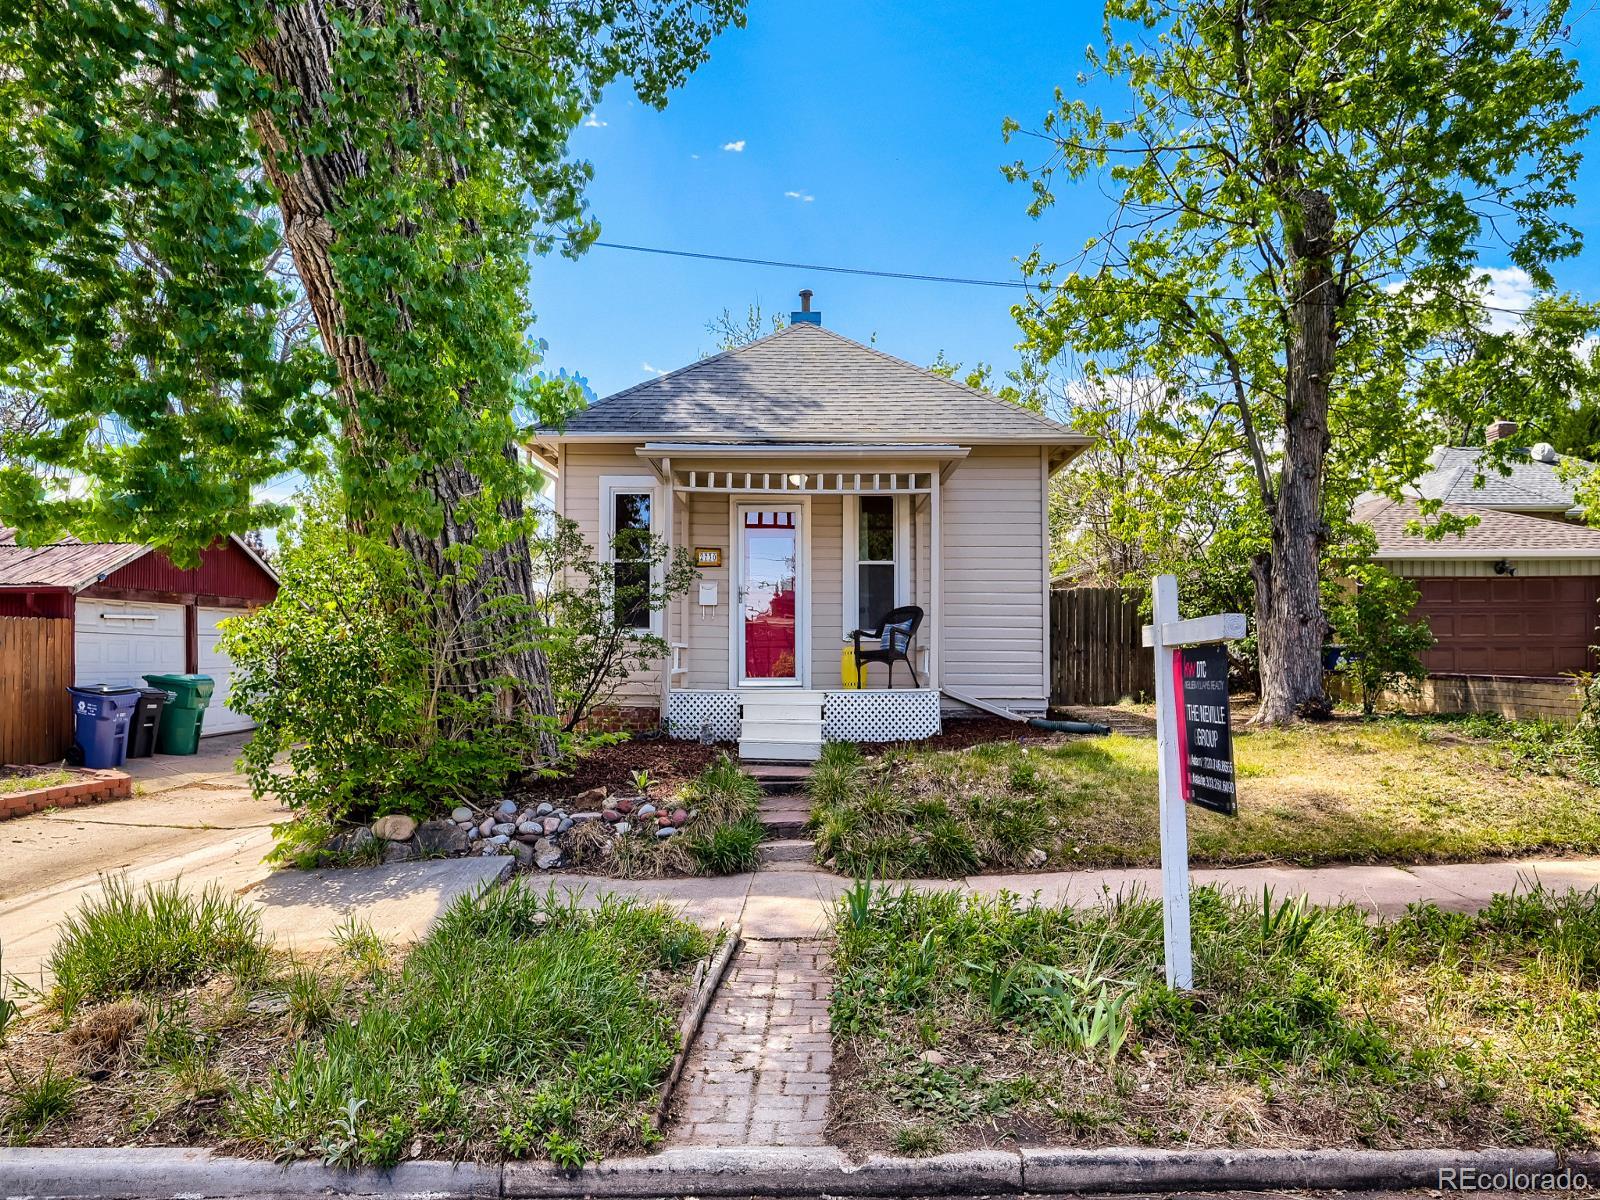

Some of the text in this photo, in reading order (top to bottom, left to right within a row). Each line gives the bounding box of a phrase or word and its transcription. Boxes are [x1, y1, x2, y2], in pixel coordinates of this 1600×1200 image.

[1196, 660, 1207, 678] DTC
[1186, 704, 1226, 724] THE NEVILLE
[1196, 728, 1219, 748] GROUP
